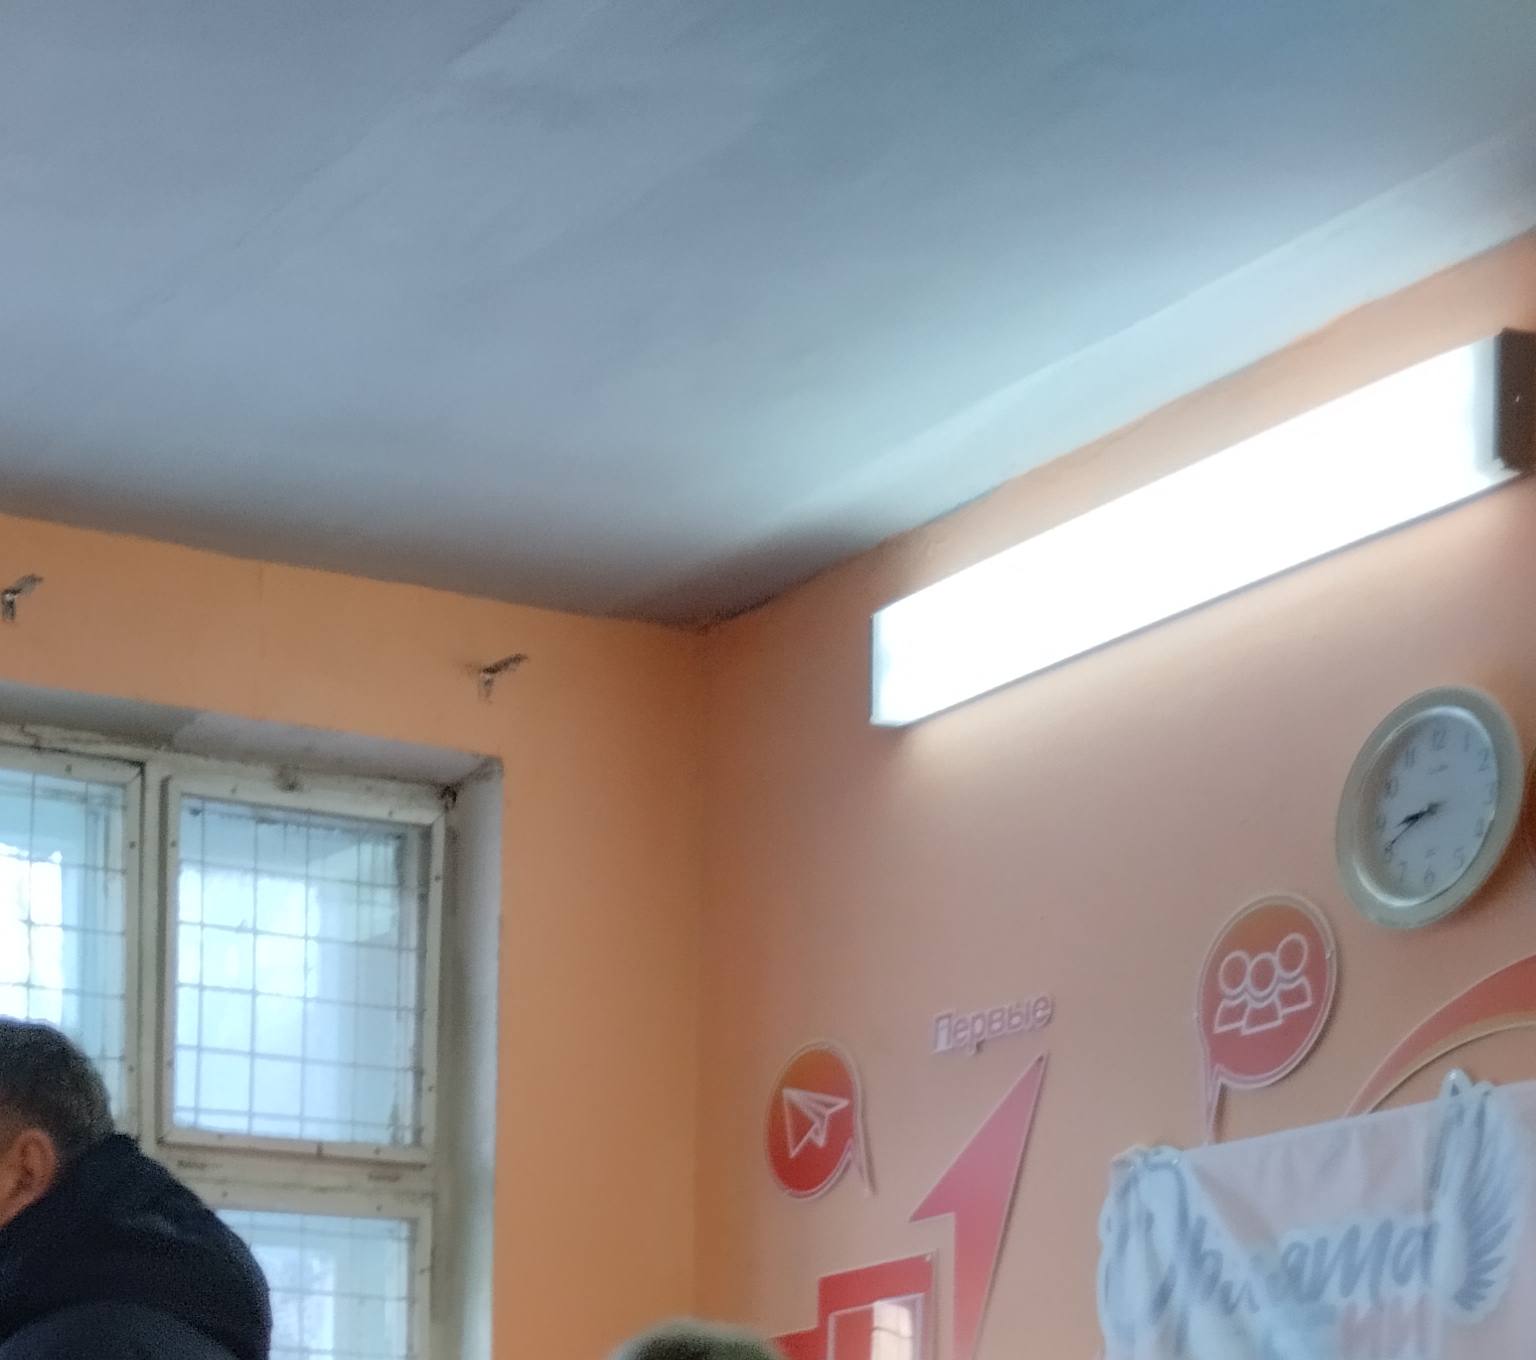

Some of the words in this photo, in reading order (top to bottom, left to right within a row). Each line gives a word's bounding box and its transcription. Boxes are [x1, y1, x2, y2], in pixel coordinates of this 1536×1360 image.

[1431, 728, 1447, 751] 12
[1477, 748, 1490, 772] 2
[1423, 865, 1436, 888] 6
[932, 993, 1053, 1053] Первые
